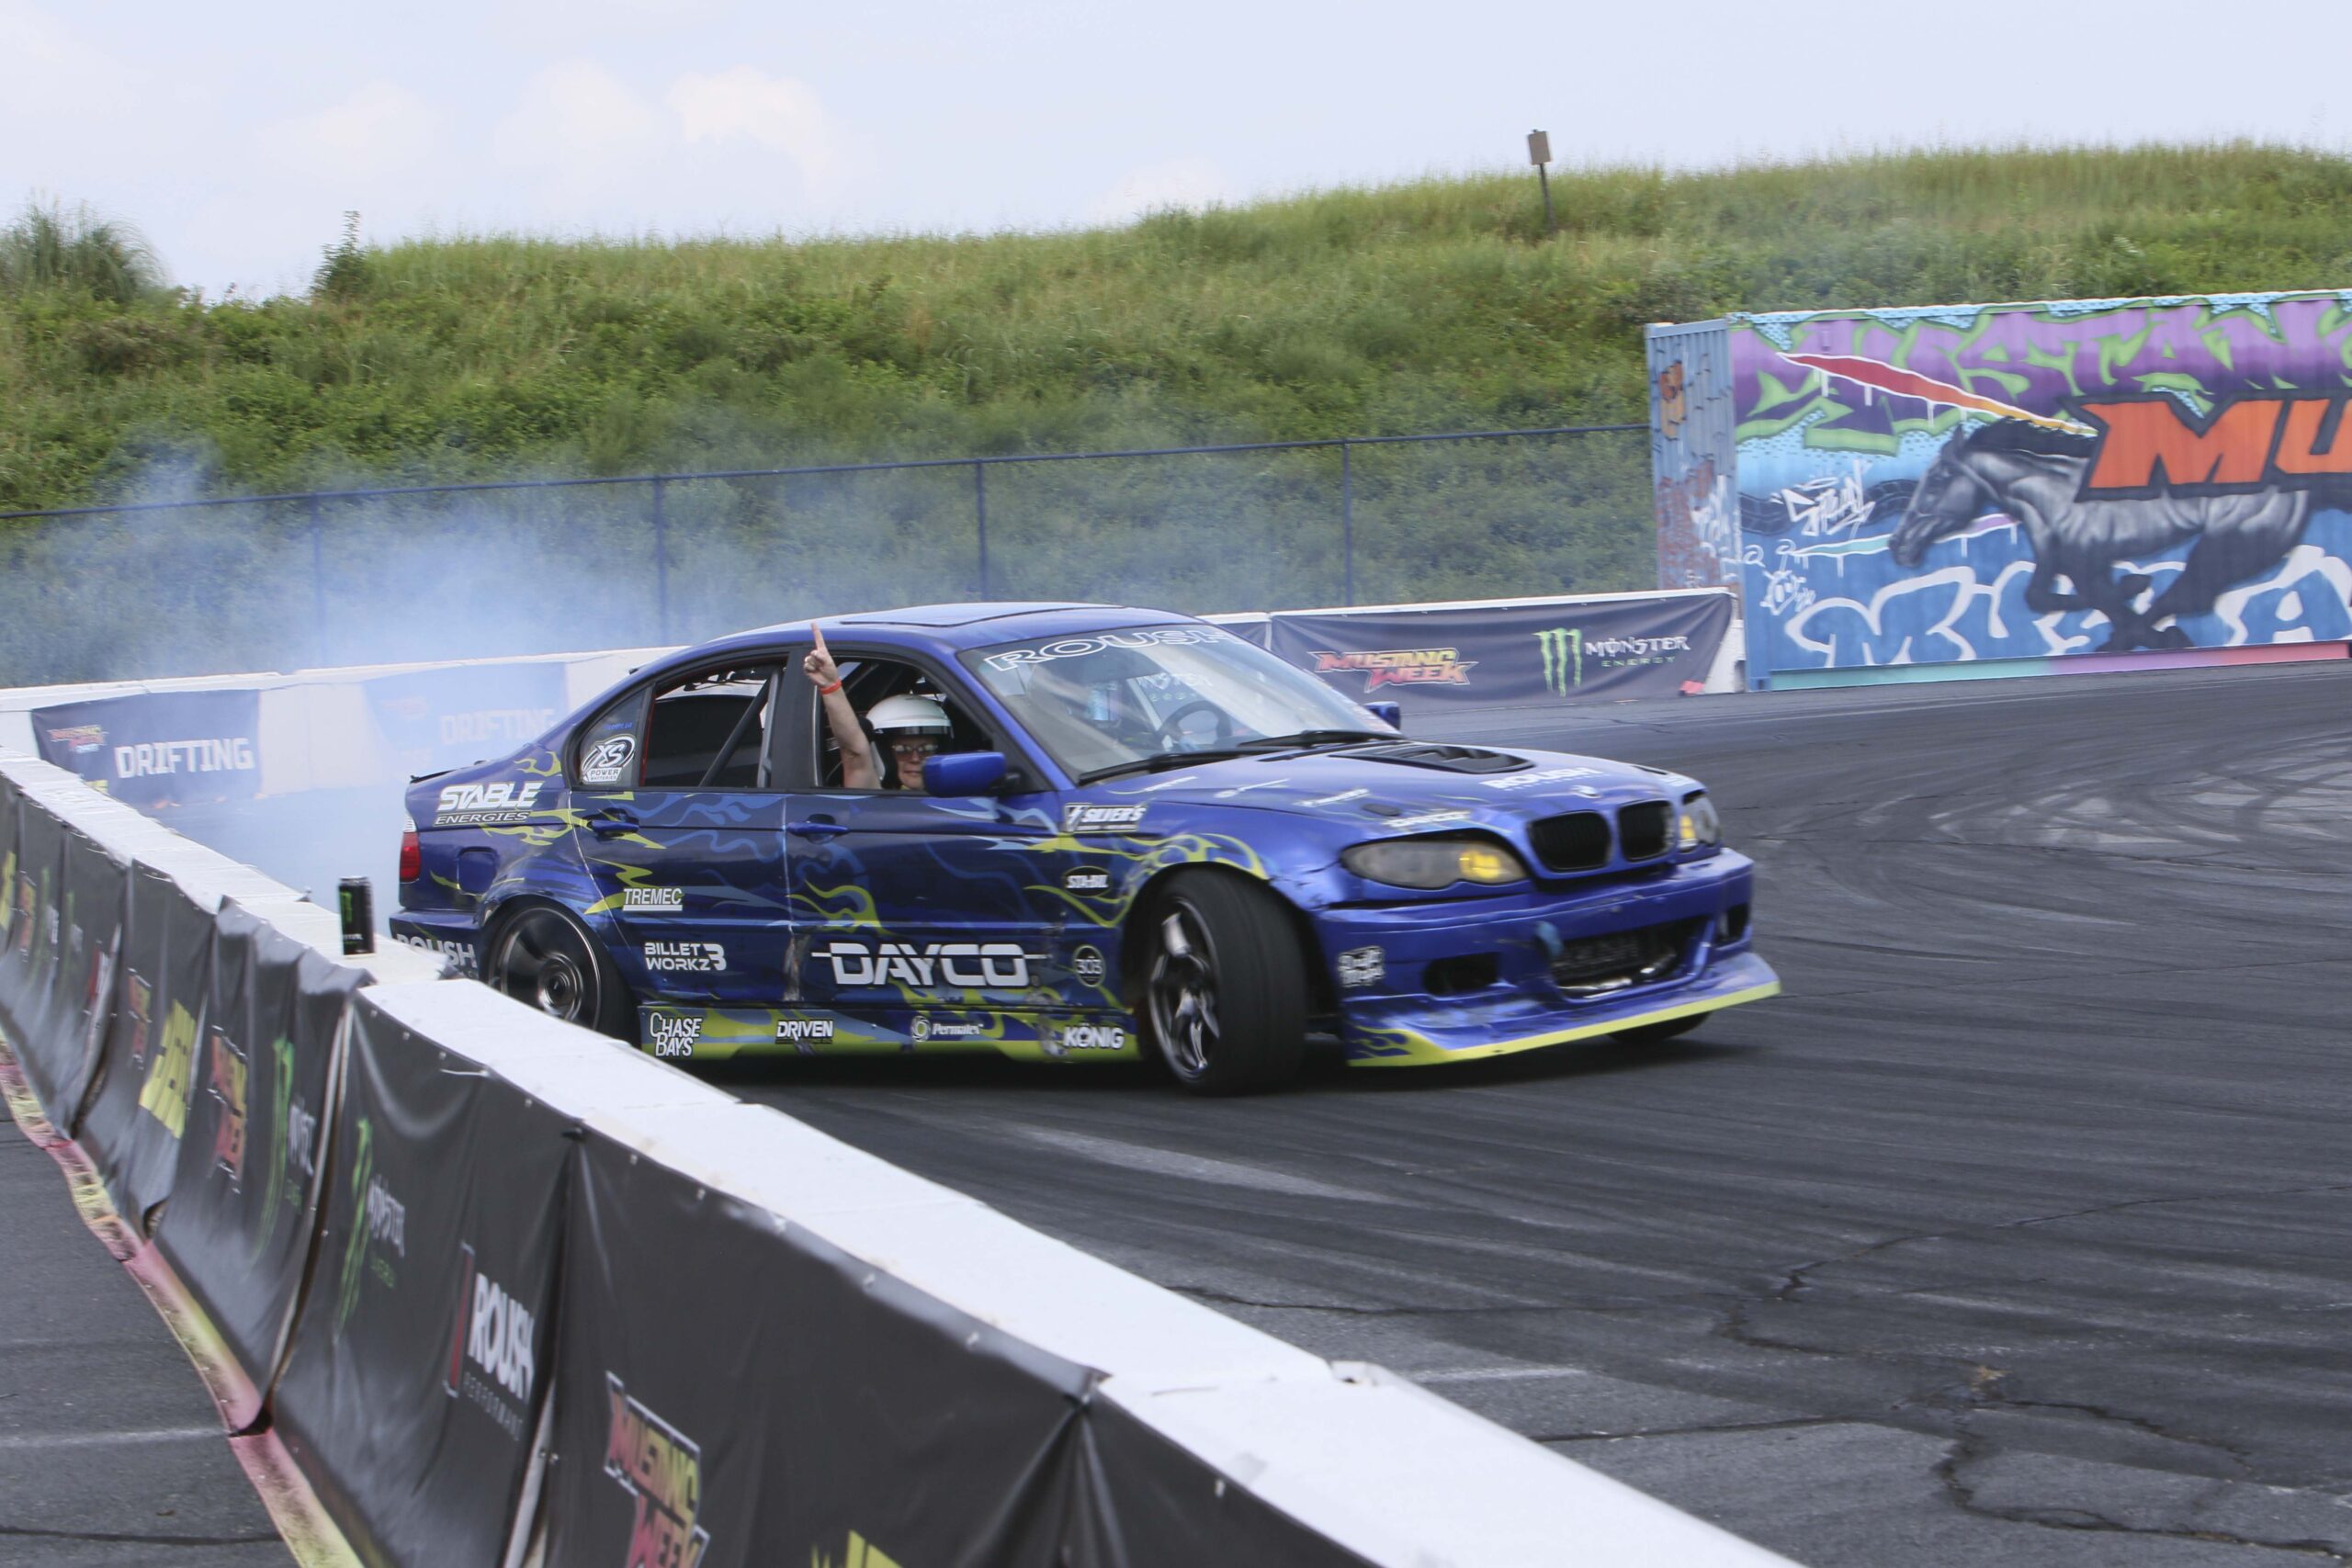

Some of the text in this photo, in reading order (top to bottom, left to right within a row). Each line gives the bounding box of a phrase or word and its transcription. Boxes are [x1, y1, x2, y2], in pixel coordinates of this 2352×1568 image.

[983, 630, 1235, 672] ROUSH
[1585, 636, 1691, 658] MONSTER
[1316, 649, 1457, 671] MUSTANG
[1365, 661, 1472, 689] WEEK
[114, 738, 255, 779] DRIFTING
[595, 743, 627, 768] XS
[590, 768, 619, 776] POWER
[435, 781, 545, 811] STABLE
[435, 811, 530, 825] ENERGIES
[623, 888, 683, 905] TREMEC
[645, 942, 701, 956] BILLET
[645, 957, 711, 971] WORKZ
[830, 942, 1030, 987] DAYCO
[650, 1012, 702, 1038] CHASE
[776, 1020, 833, 1042] DRIVEN
[655, 1031, 695, 1056] BAYS
[467, 1272, 536, 1405] ROUSH
